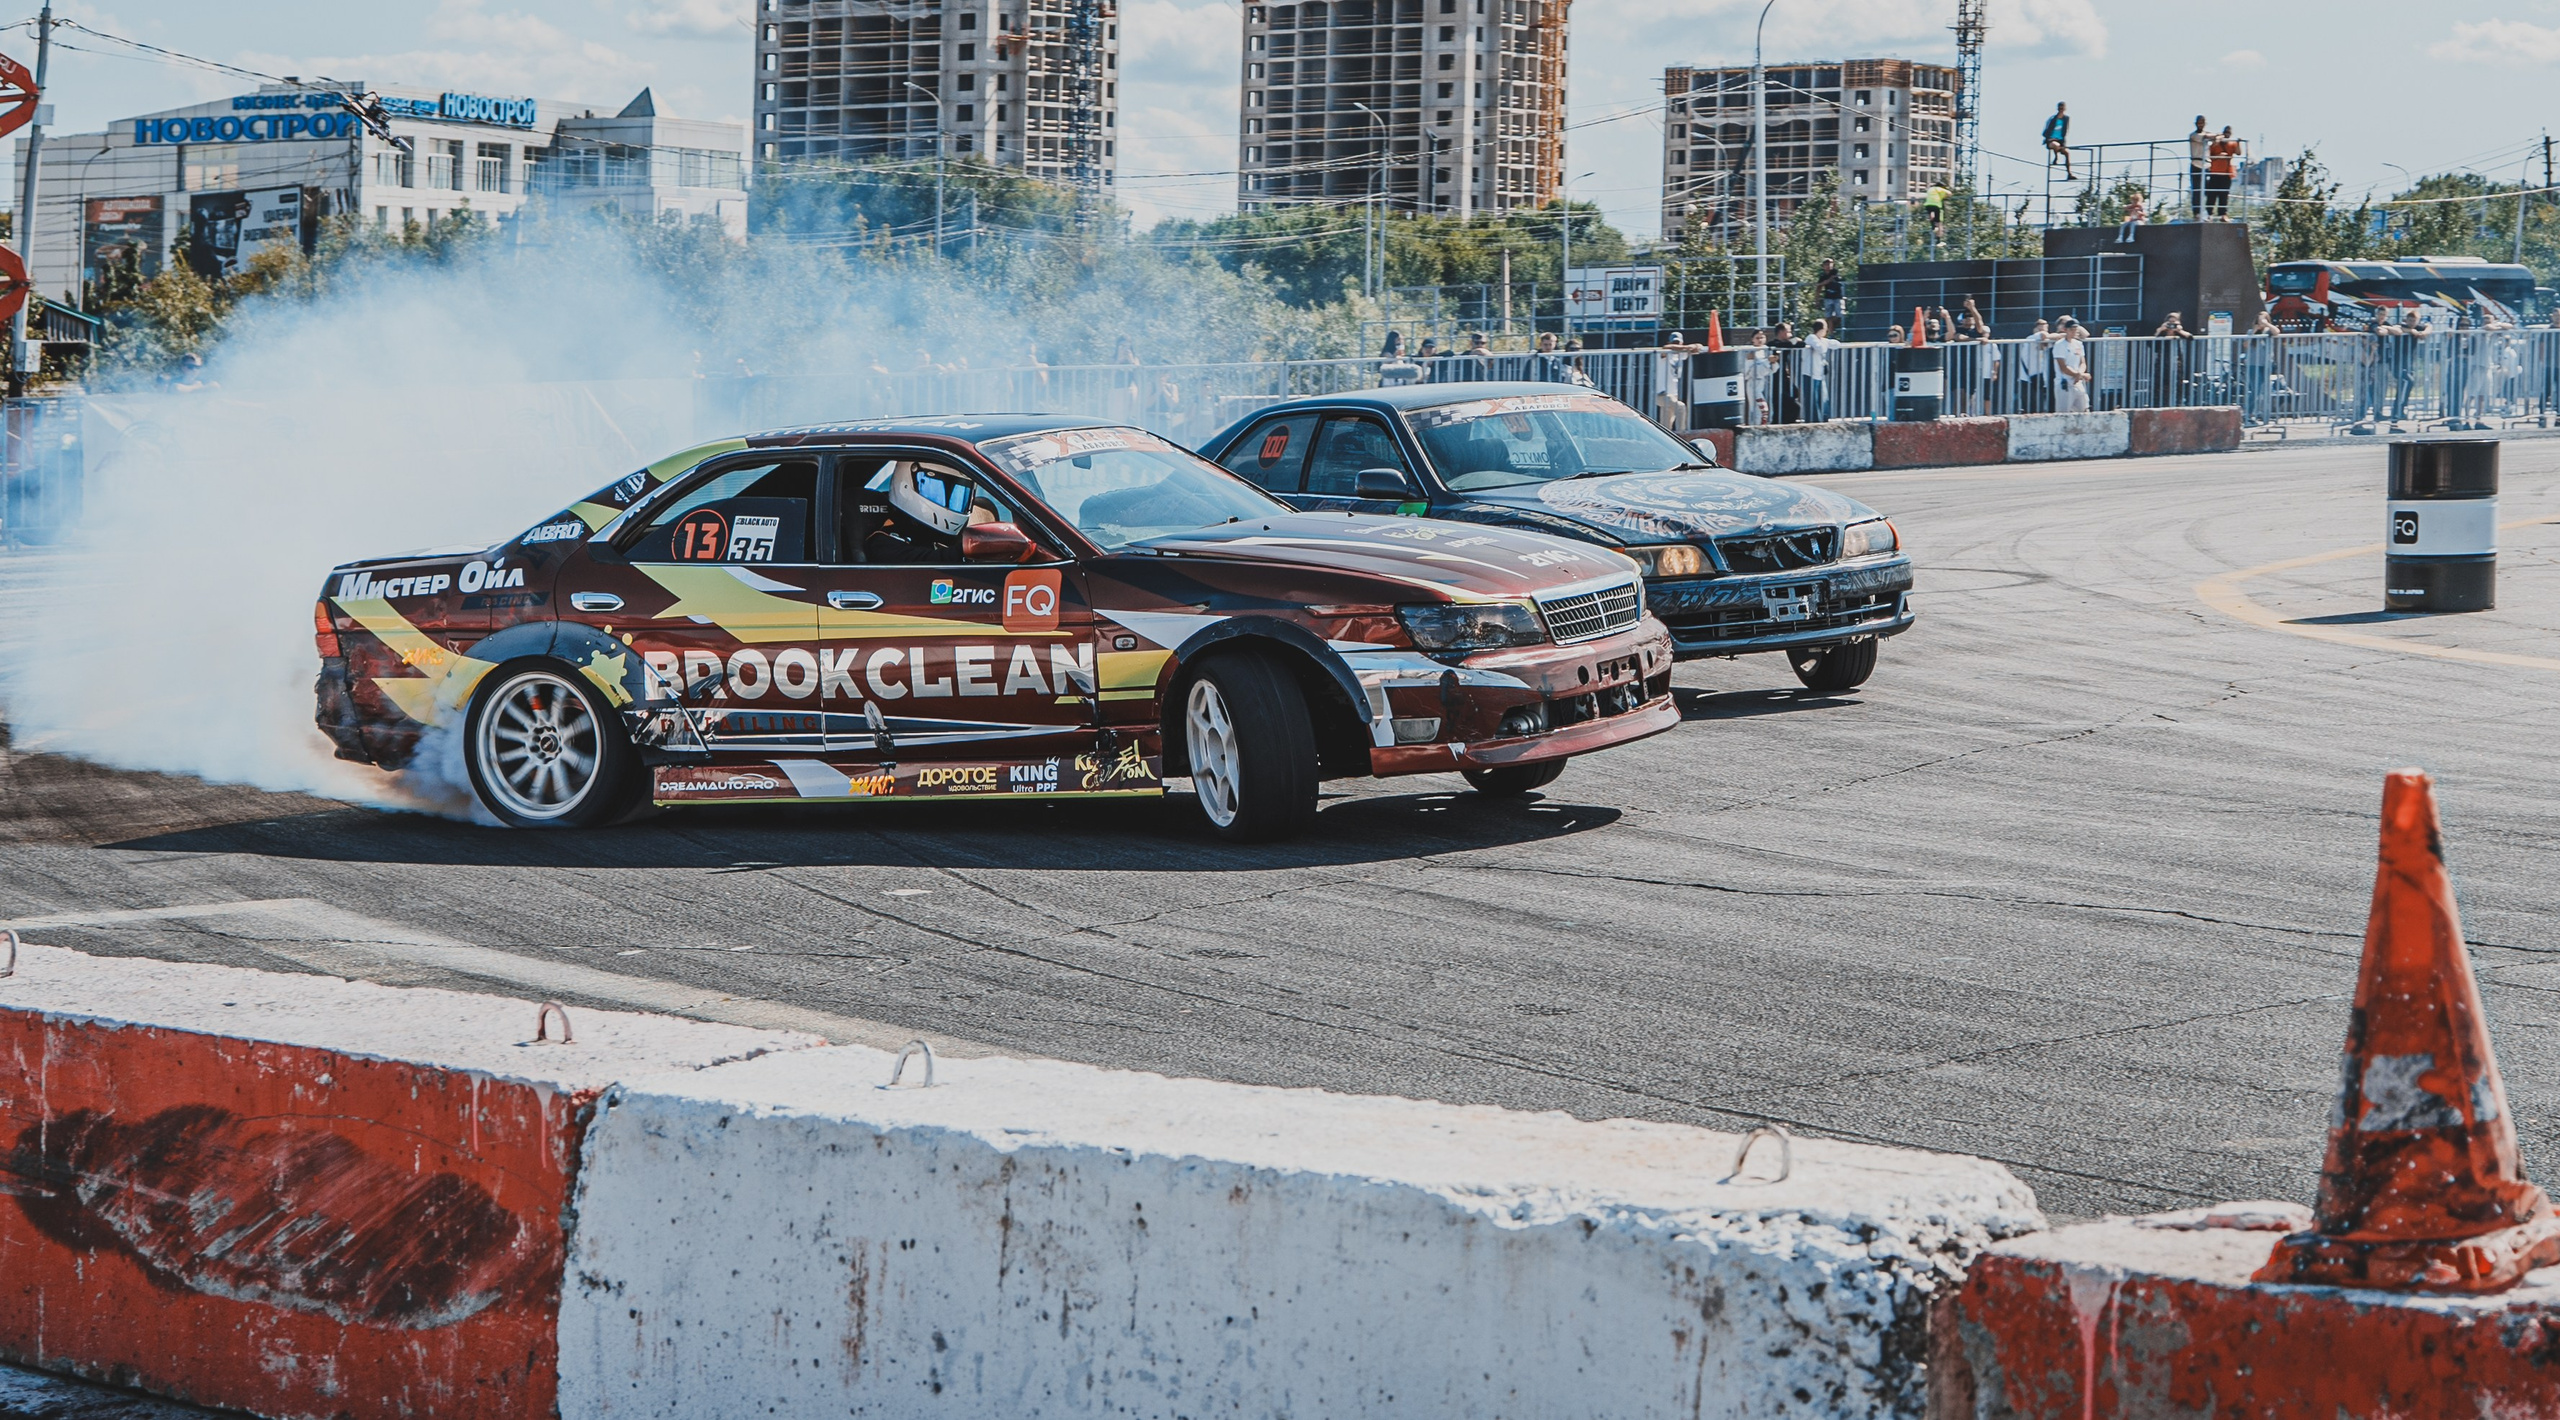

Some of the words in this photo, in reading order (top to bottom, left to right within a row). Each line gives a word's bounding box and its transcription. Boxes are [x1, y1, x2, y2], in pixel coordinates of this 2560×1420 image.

[444, 92, 536, 123] НОВОСТРОЙ
[1261, 435, 1288, 459] 100
[859, 504, 889, 513] BRIDE
[523, 521, 583, 543] ABRO
[740, 517, 760, 526] BLACK
[761, 518, 778, 527] AUTO
[2394, 519, 2417, 536] FQ
[684, 522, 720, 560] 13
[730, 537, 774, 561] 35
[952, 588, 996, 604] 2ГИС
[1006, 584, 1057, 617] FQ
[643, 642, 1095, 701] BROOKCLEAN
[917, 767, 997, 787] ДОРОГОЕ
[1010, 764, 1058, 781] KING
[659, 780, 776, 792] DREAMAUTO.PRO
[1012, 784, 1034, 793] Ultra
[1036, 782, 1058, 793] PPF
